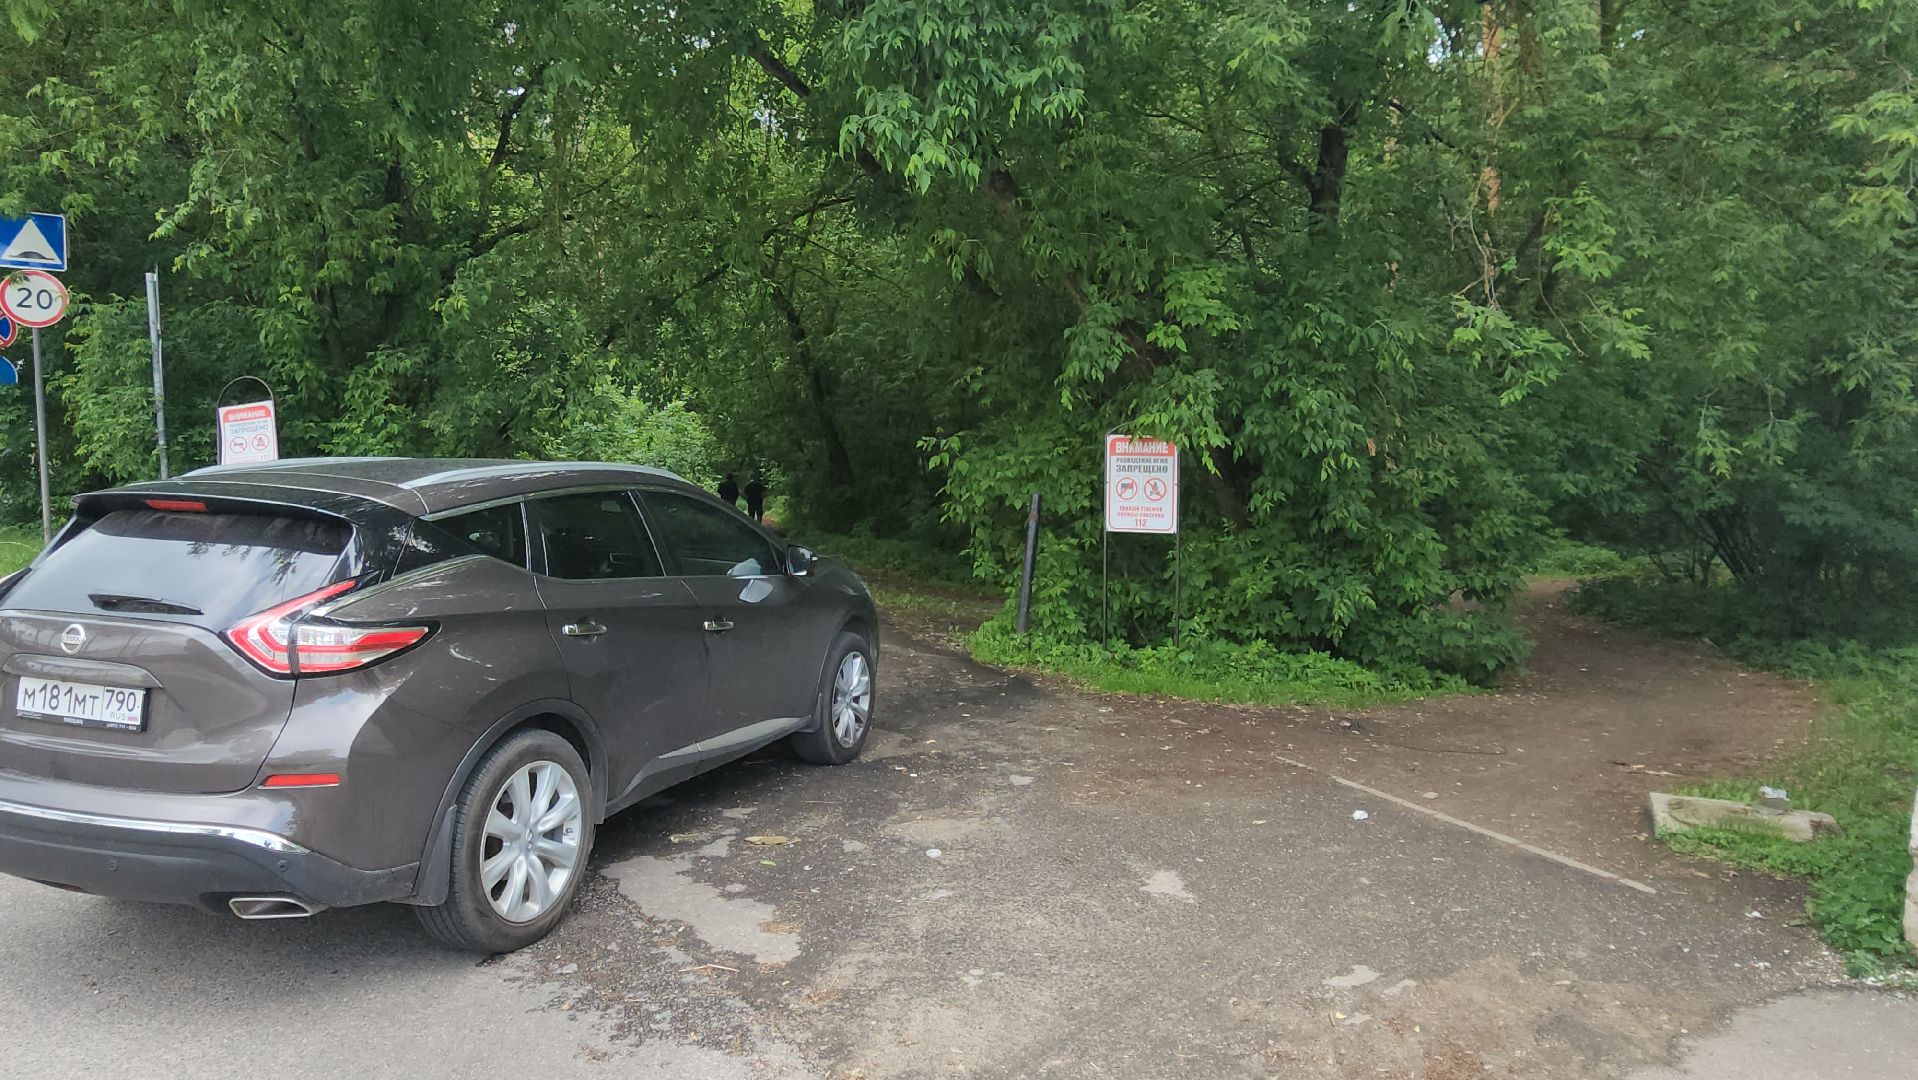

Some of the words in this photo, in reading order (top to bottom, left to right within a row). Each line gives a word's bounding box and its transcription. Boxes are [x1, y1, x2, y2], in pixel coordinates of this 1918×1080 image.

[16, 287, 53, 310] 20
[1115, 441, 1169, 454] ВНИМАНИЕ
[1116, 464, 1168, 474] ЗАПРЕЩЕНО
[1135, 518, 1147, 527] 112
[105, 689, 137, 713] 790
[110, 711, 127, 721] RUS
